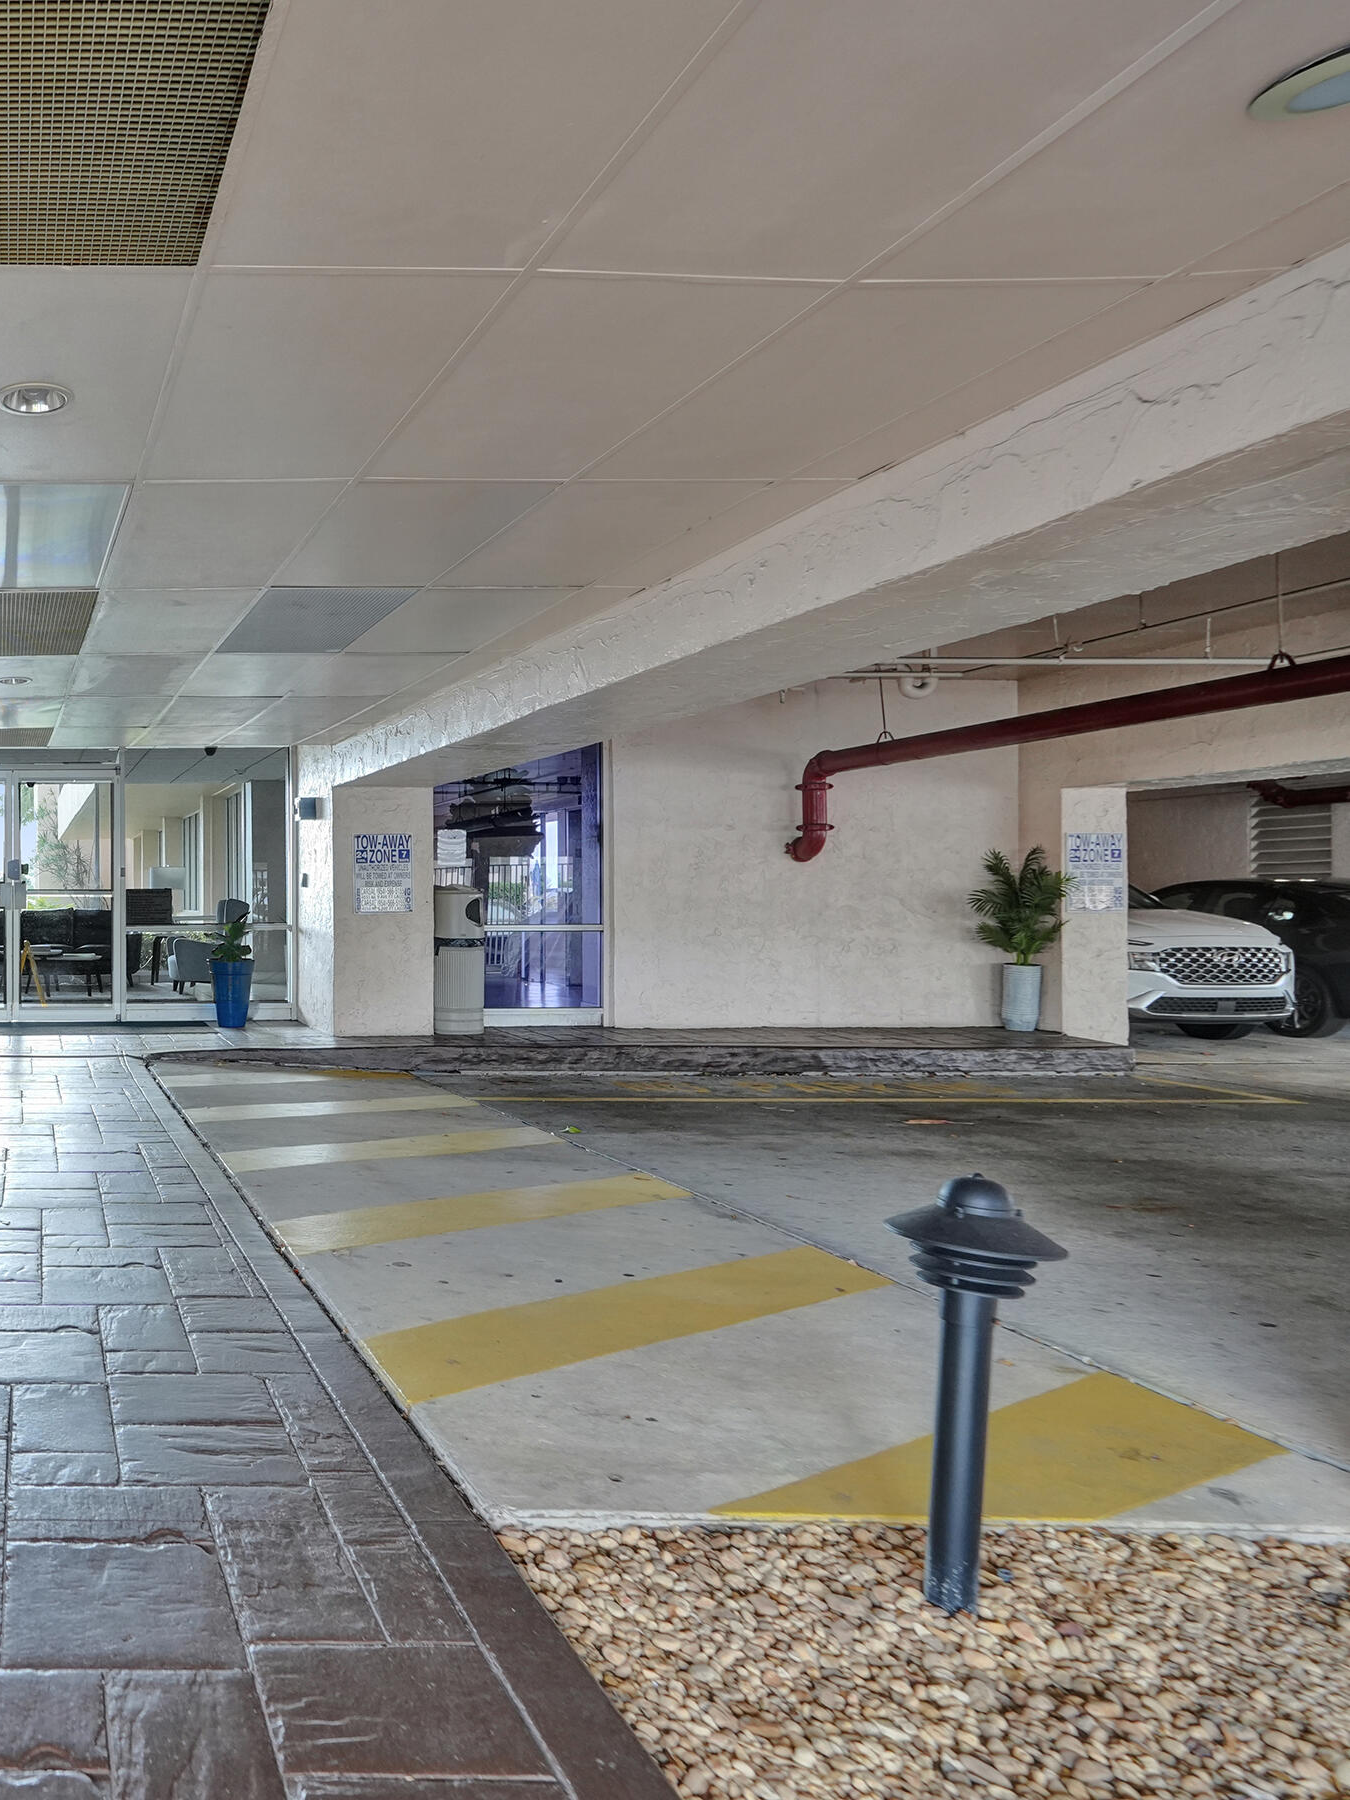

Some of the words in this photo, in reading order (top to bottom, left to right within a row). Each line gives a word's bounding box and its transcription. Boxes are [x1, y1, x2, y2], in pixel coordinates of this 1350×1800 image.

[354, 834, 412, 849] TOW-AWAY
[1068, 833, 1123, 848] TOW-AWAY
[356, 850, 367, 859] 24
[369, 849, 397, 863] ZONE
[1082, 848, 1109, 862] ZONE
